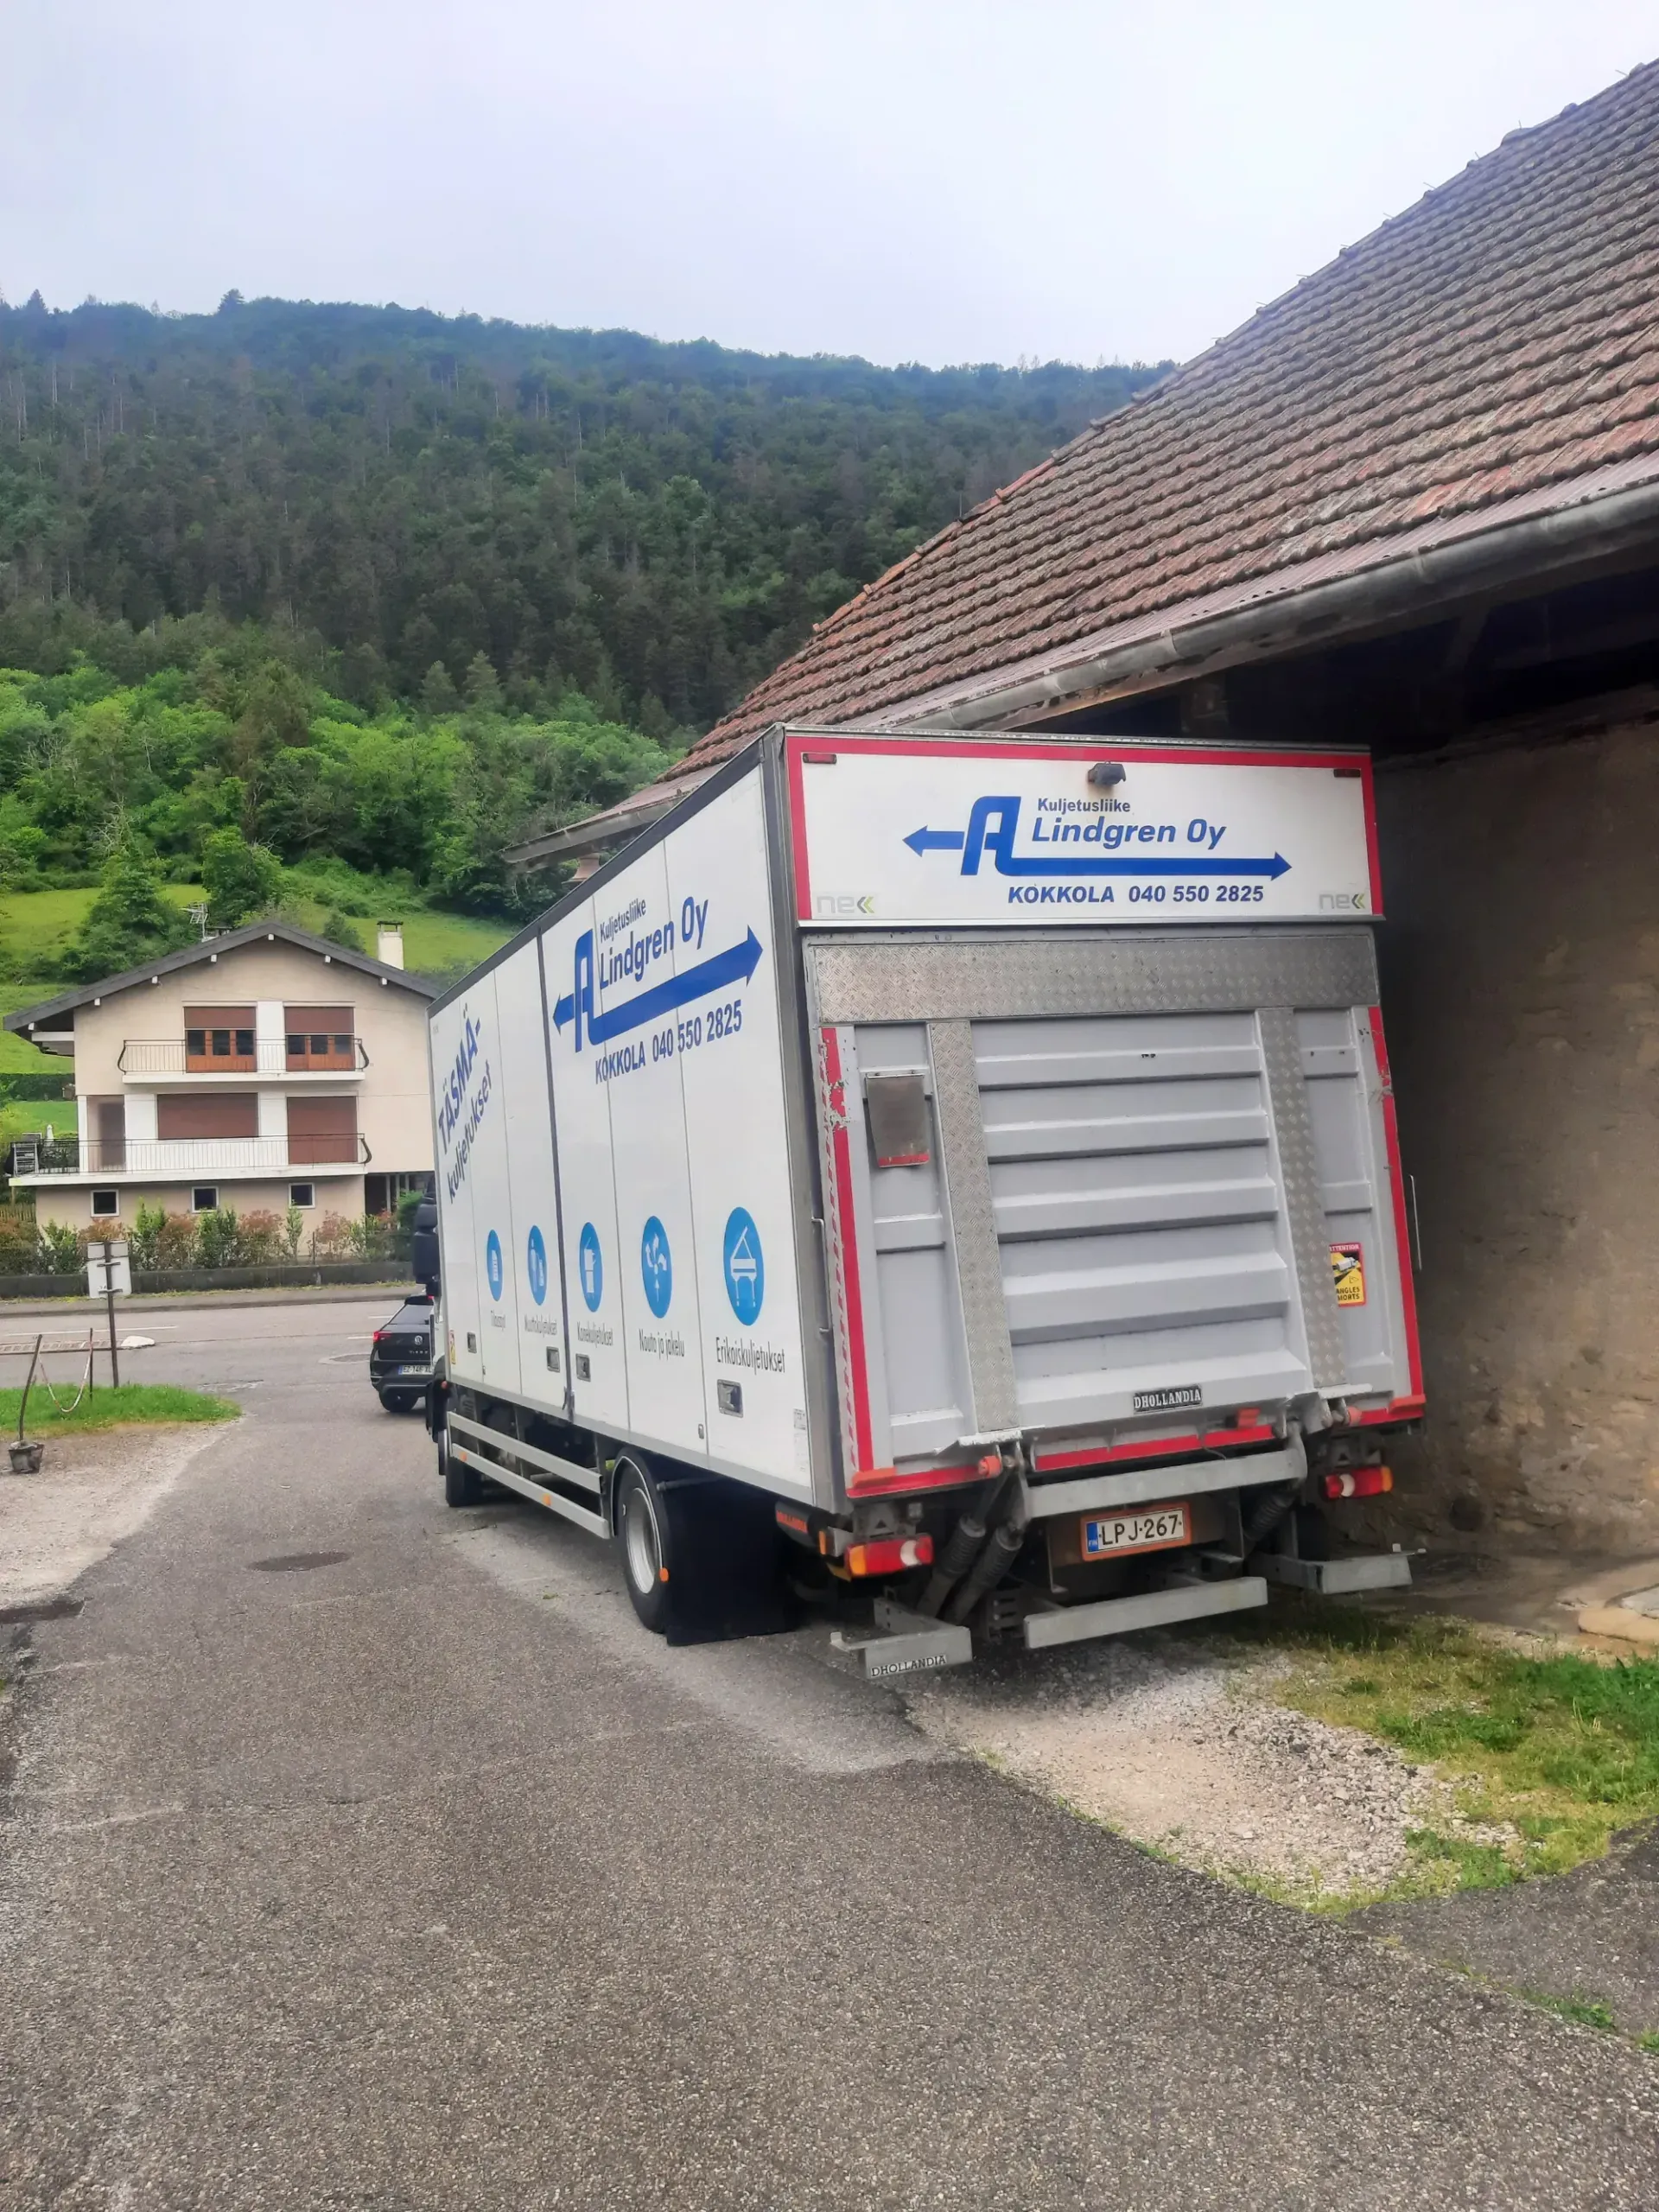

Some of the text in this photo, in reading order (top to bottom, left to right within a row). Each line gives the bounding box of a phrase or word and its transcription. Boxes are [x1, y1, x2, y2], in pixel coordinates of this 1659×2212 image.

[1038, 798, 1130, 814] Kuljetusliike
[1032, 816, 1226, 849] Lindgren Oy
[1007, 884, 1264, 903] KOKKOLA 040 550 2825
[600, 898, 646, 944] Kuljetusliike
[600, 896, 709, 990] Lindgren Oy
[595, 999, 742, 1084] KOKKOLA 040 550 2825
[438, 1002, 481, 1154] TÄSMÄ-
[448, 1059, 492, 1204] kuljetukset
[639, 1328, 685, 1361] Nouto ja jakelu
[716, 1337, 785, 1376] Erikoiskuljetukset
[1134, 1389, 1201, 1408] DHOLLANDIA
[1101, 1514, 1179, 1545] LPJ-267
[871, 1655, 946, 1677] DHOLLANDIA
